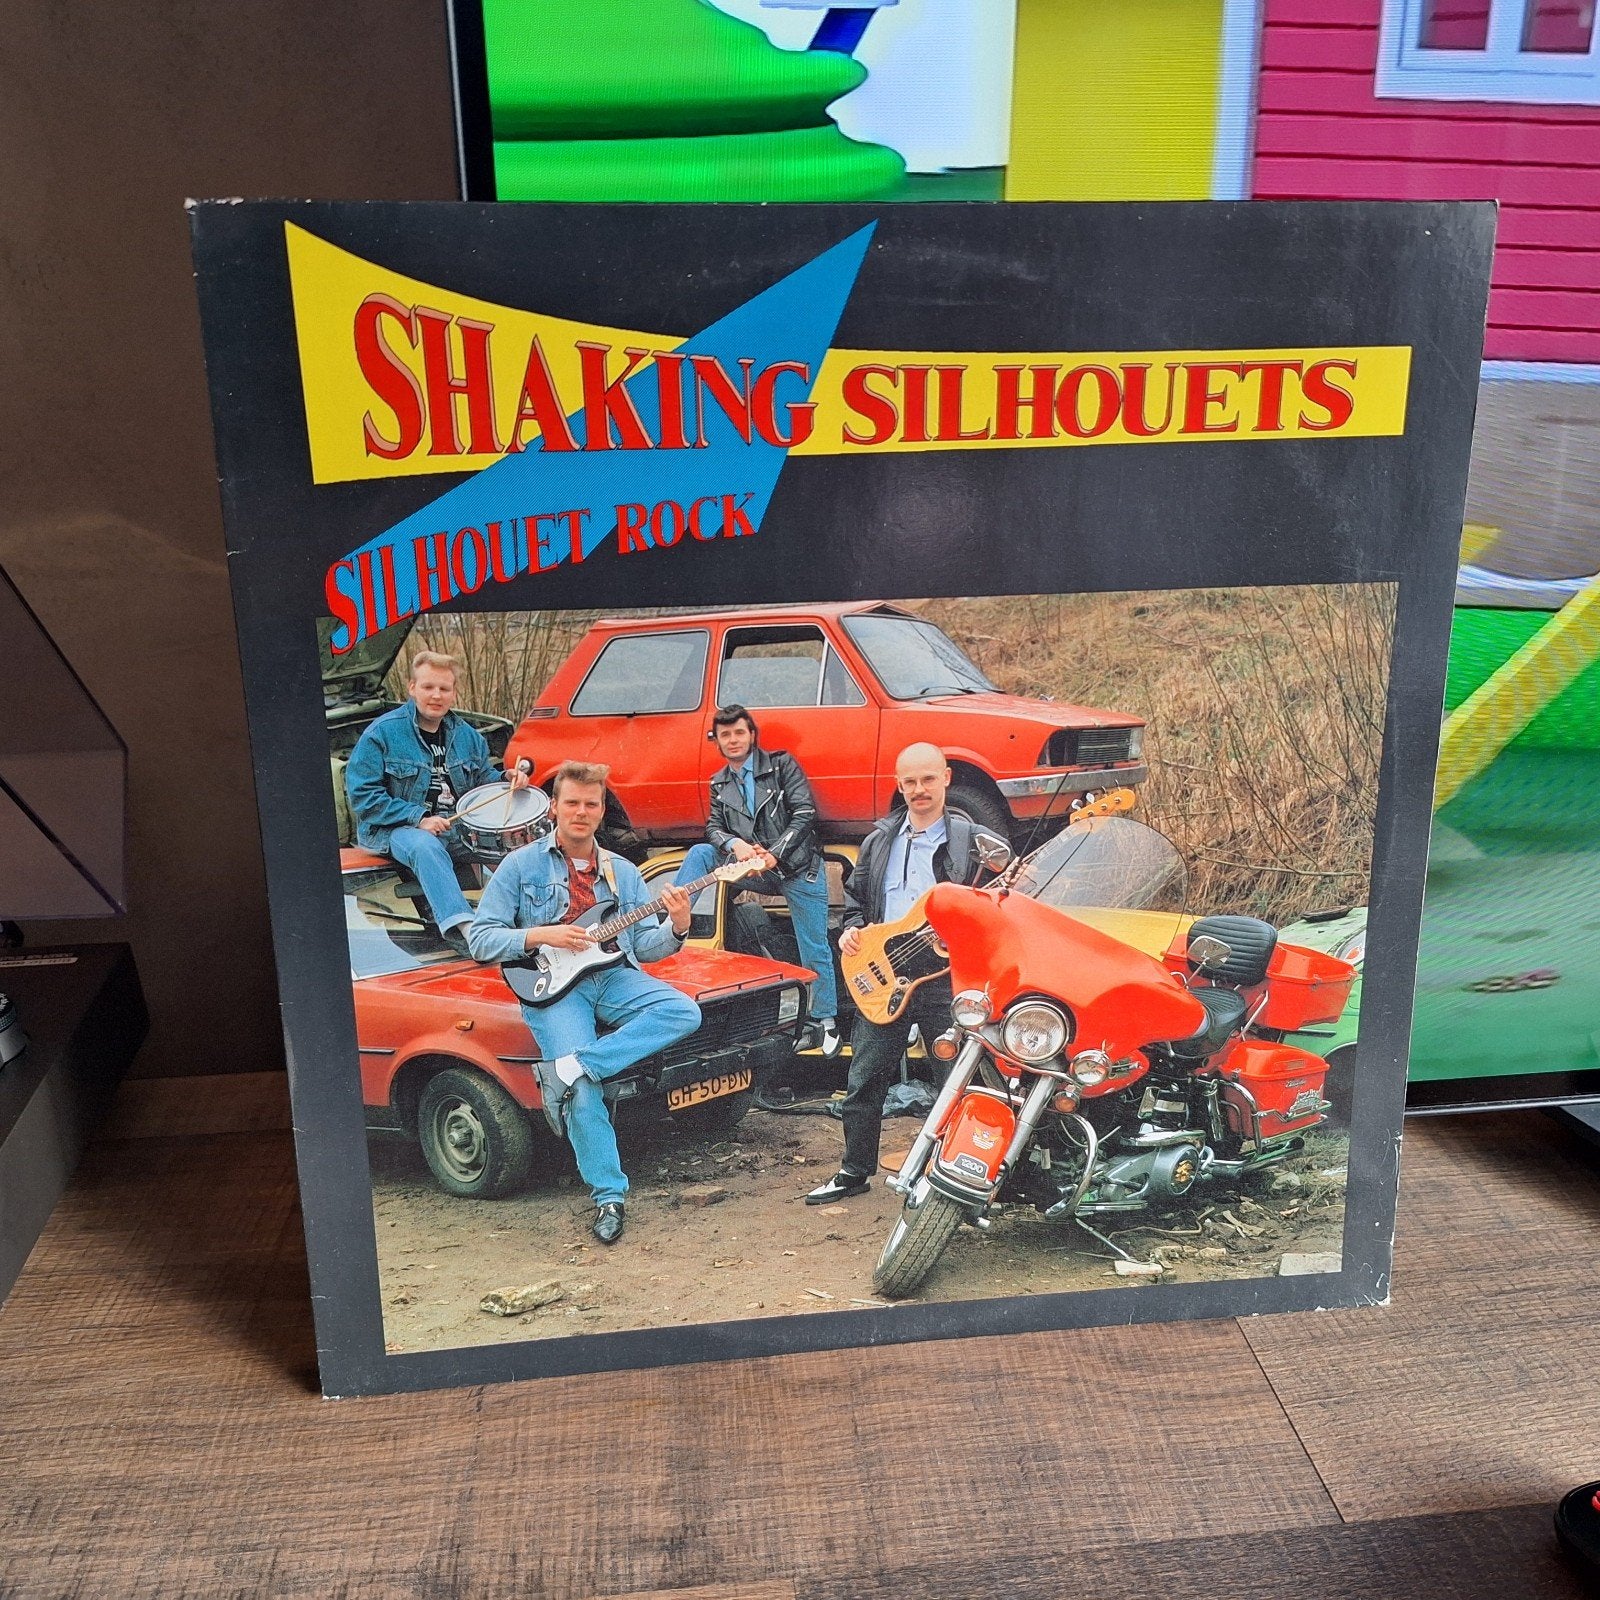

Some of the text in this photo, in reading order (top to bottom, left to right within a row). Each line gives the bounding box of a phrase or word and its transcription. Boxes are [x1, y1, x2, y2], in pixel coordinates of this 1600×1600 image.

[354, 292, 1357, 460] SHAKING SILHOUETS
[323, 492, 756, 656] SILHOUET ROCK
[961, 1158, 984, 1174] 1200
